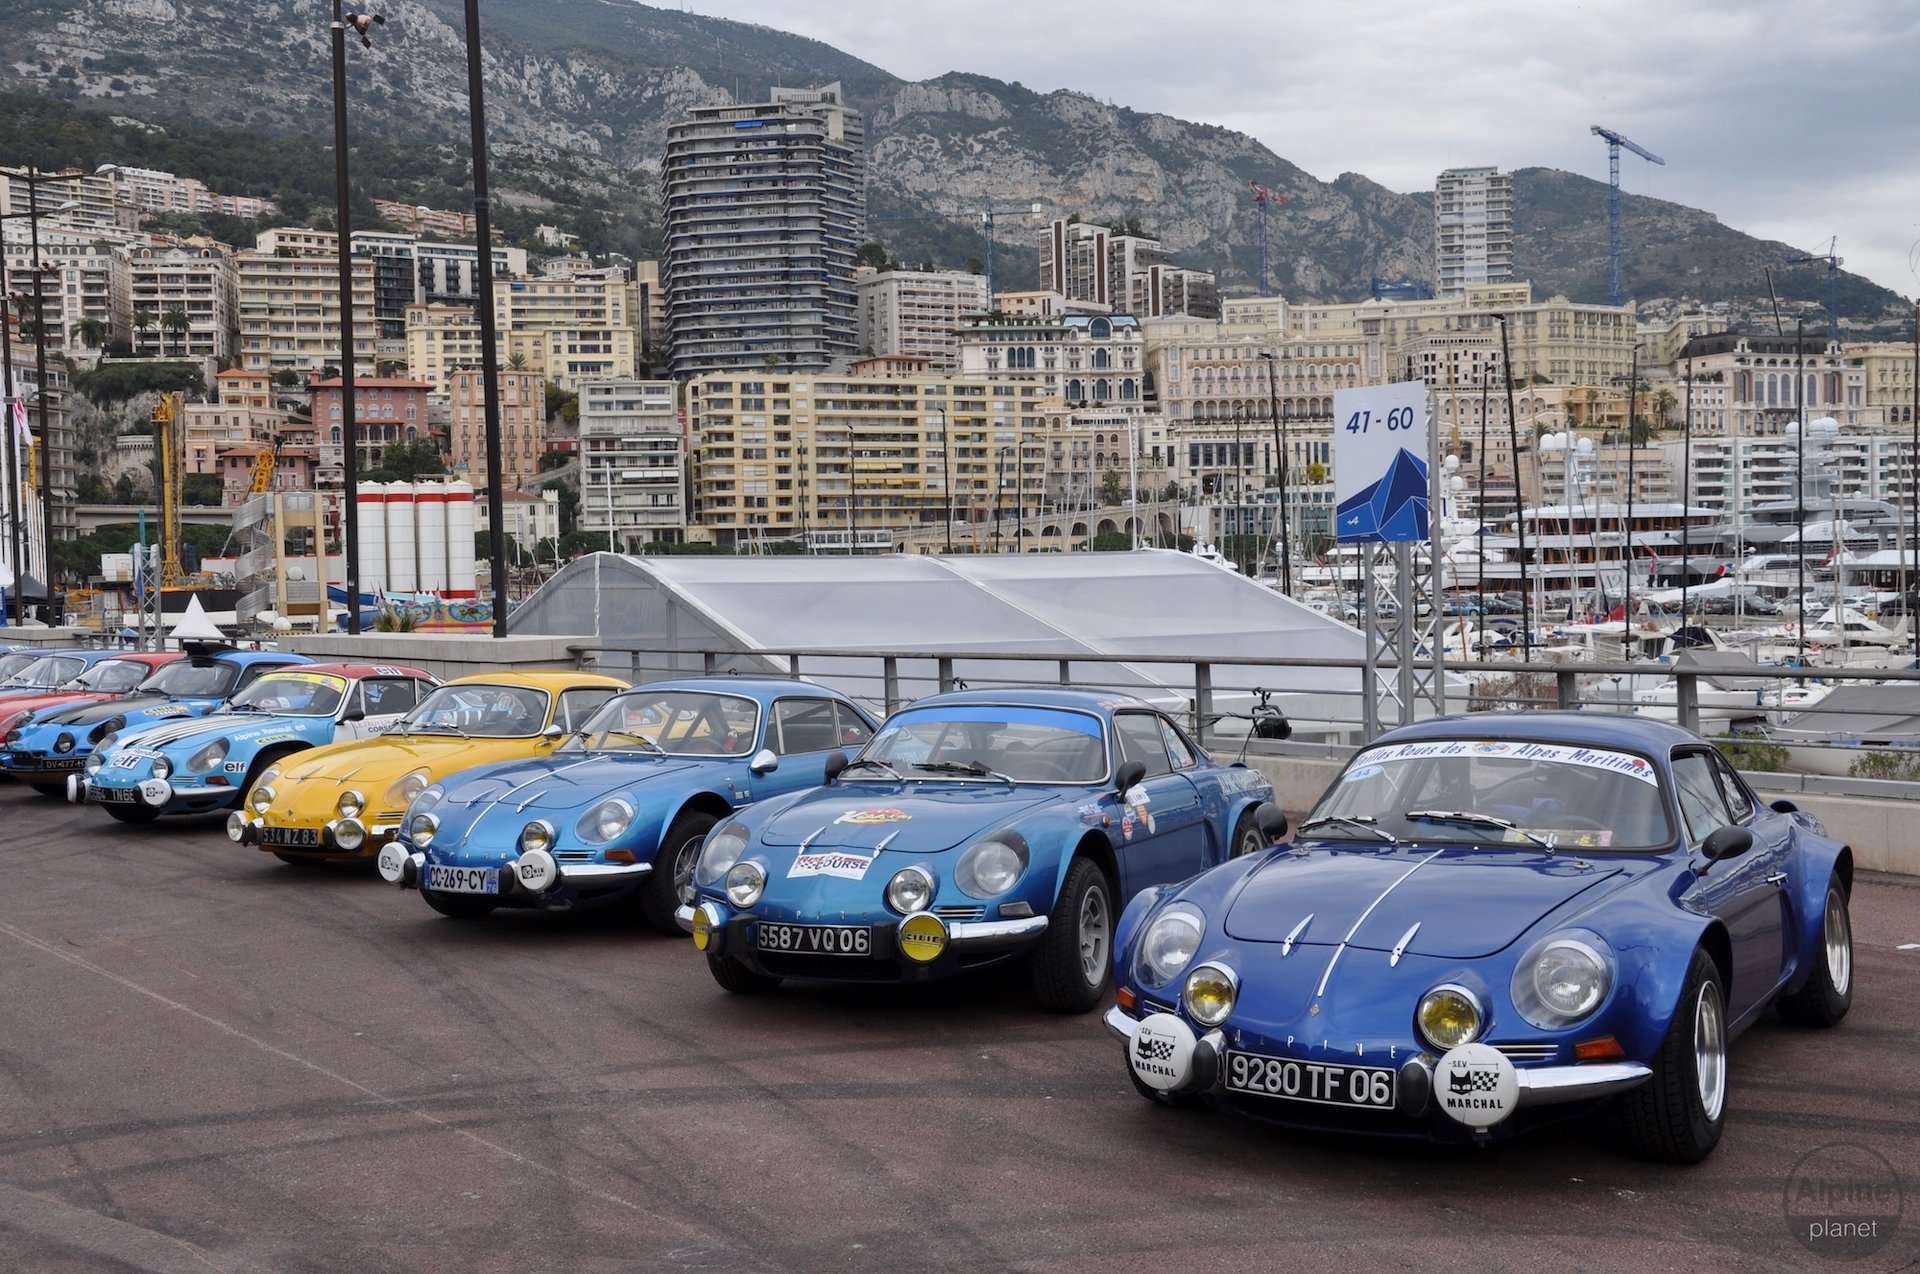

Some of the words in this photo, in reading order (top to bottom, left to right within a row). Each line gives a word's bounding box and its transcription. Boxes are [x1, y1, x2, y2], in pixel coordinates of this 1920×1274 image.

[1346, 410, 1371, 434] 41
[1387, 406, 1414, 431] 60
[1396, 744, 1438, 758] Roues
[1440, 742, 1466, 754] des
[113, 755, 140, 768] elf
[224, 762, 246, 771] elf
[263, 828, 281, 844] 534
[284, 828, 299, 844] NZ
[302, 829, 317, 845] 83
[430, 867, 487, 891] CC-269-CY
[759, 925, 804, 950] 5587
[809, 928, 836, 951] VQ
[840, 929, 869, 952] 06
[1135, 1060, 1177, 1077] MARCHAL
[1231, 1055, 1301, 1096] 9280
[1306, 1066, 1341, 1100] TF
[1349, 1071, 1391, 1105] 06
[1447, 1098, 1504, 1109] MARCHAL
